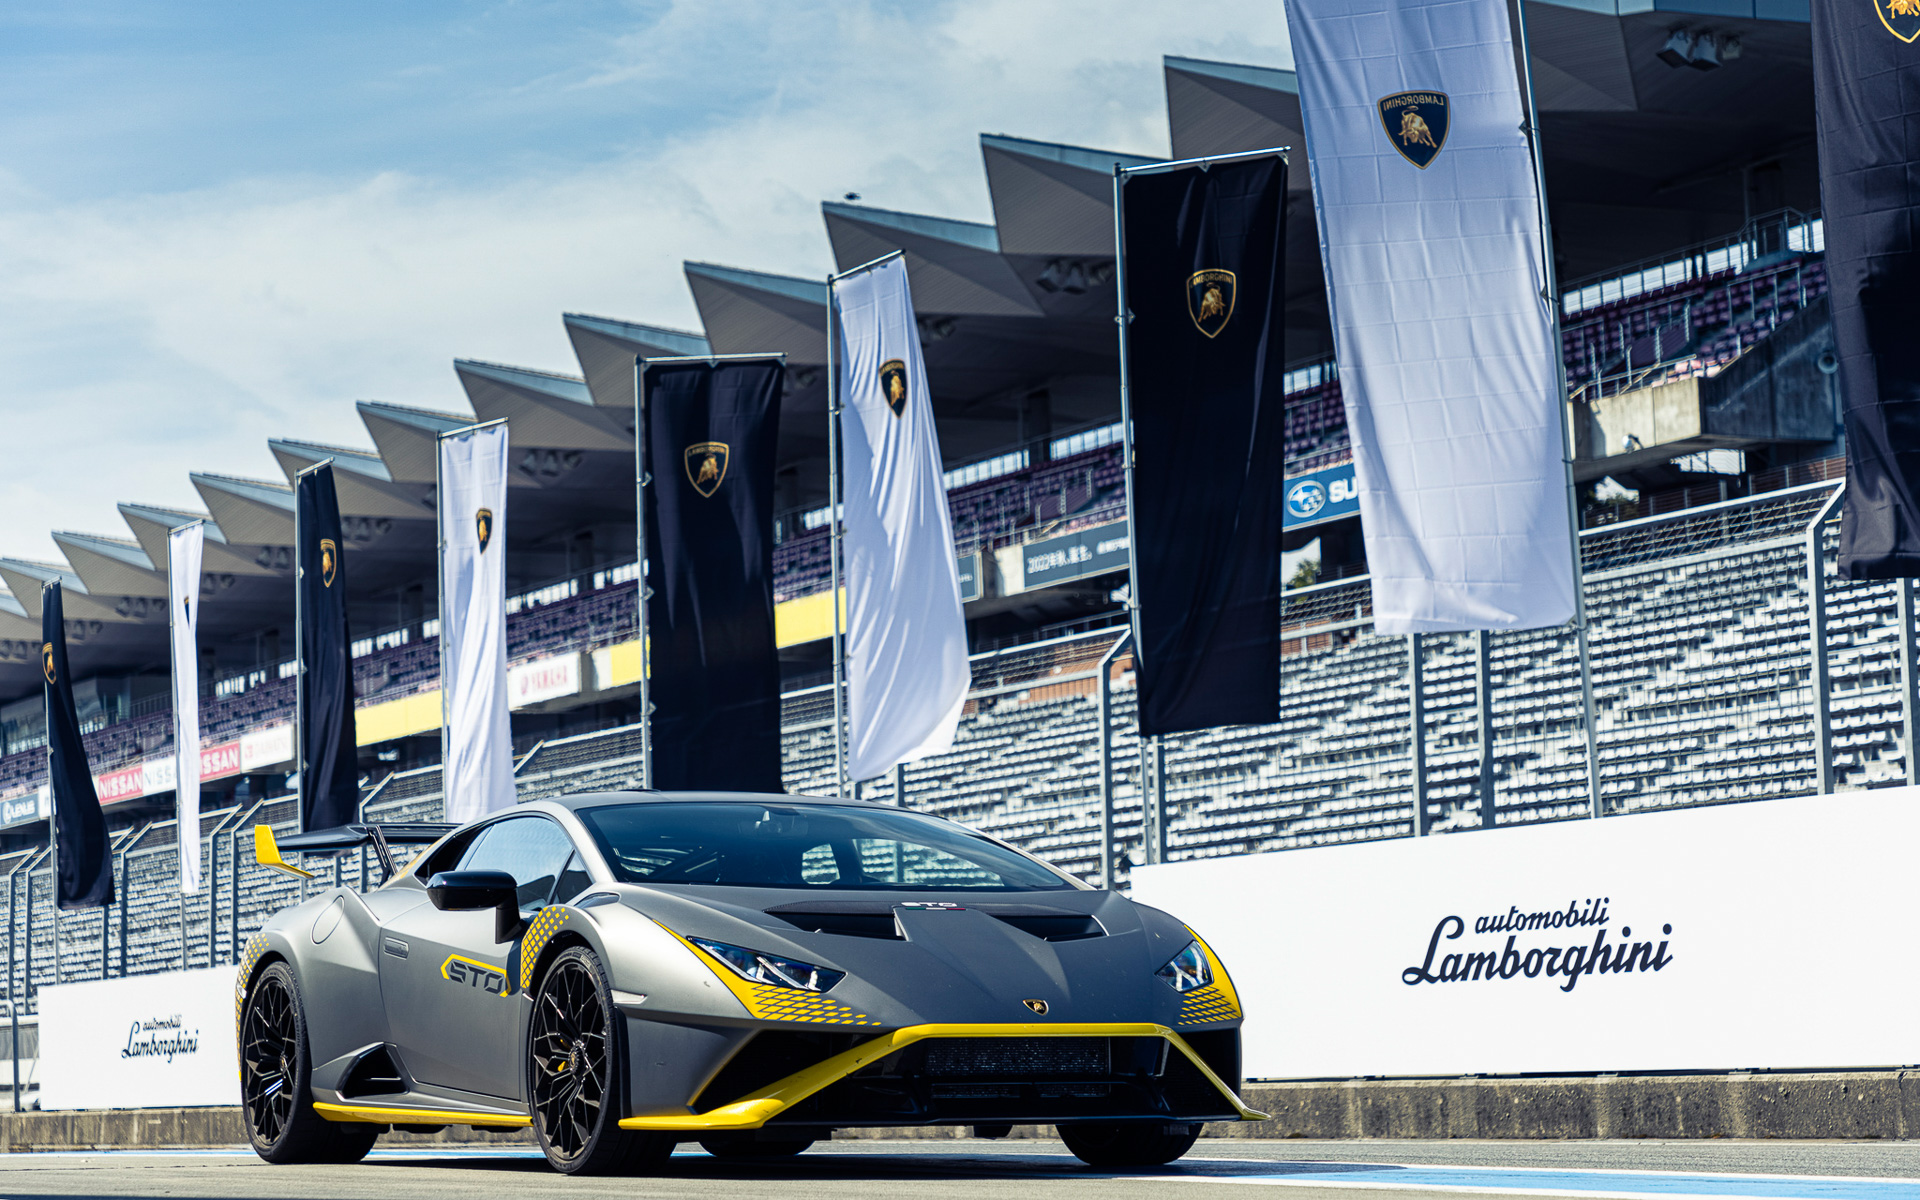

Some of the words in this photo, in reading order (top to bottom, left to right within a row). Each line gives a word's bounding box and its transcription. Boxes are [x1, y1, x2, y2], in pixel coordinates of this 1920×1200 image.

[1329, 476, 1358, 503] SU
[143, 765, 176, 787] NISS
[200, 747, 239, 775] ISSAN
[100, 770, 143, 799] NISSAN
[1475, 897, 1610, 934] automobili
[1402, 915, 1673, 993] Lamborghini
[449, 961, 504, 994] STO
[121, 1021, 199, 1064] Lamborghini
